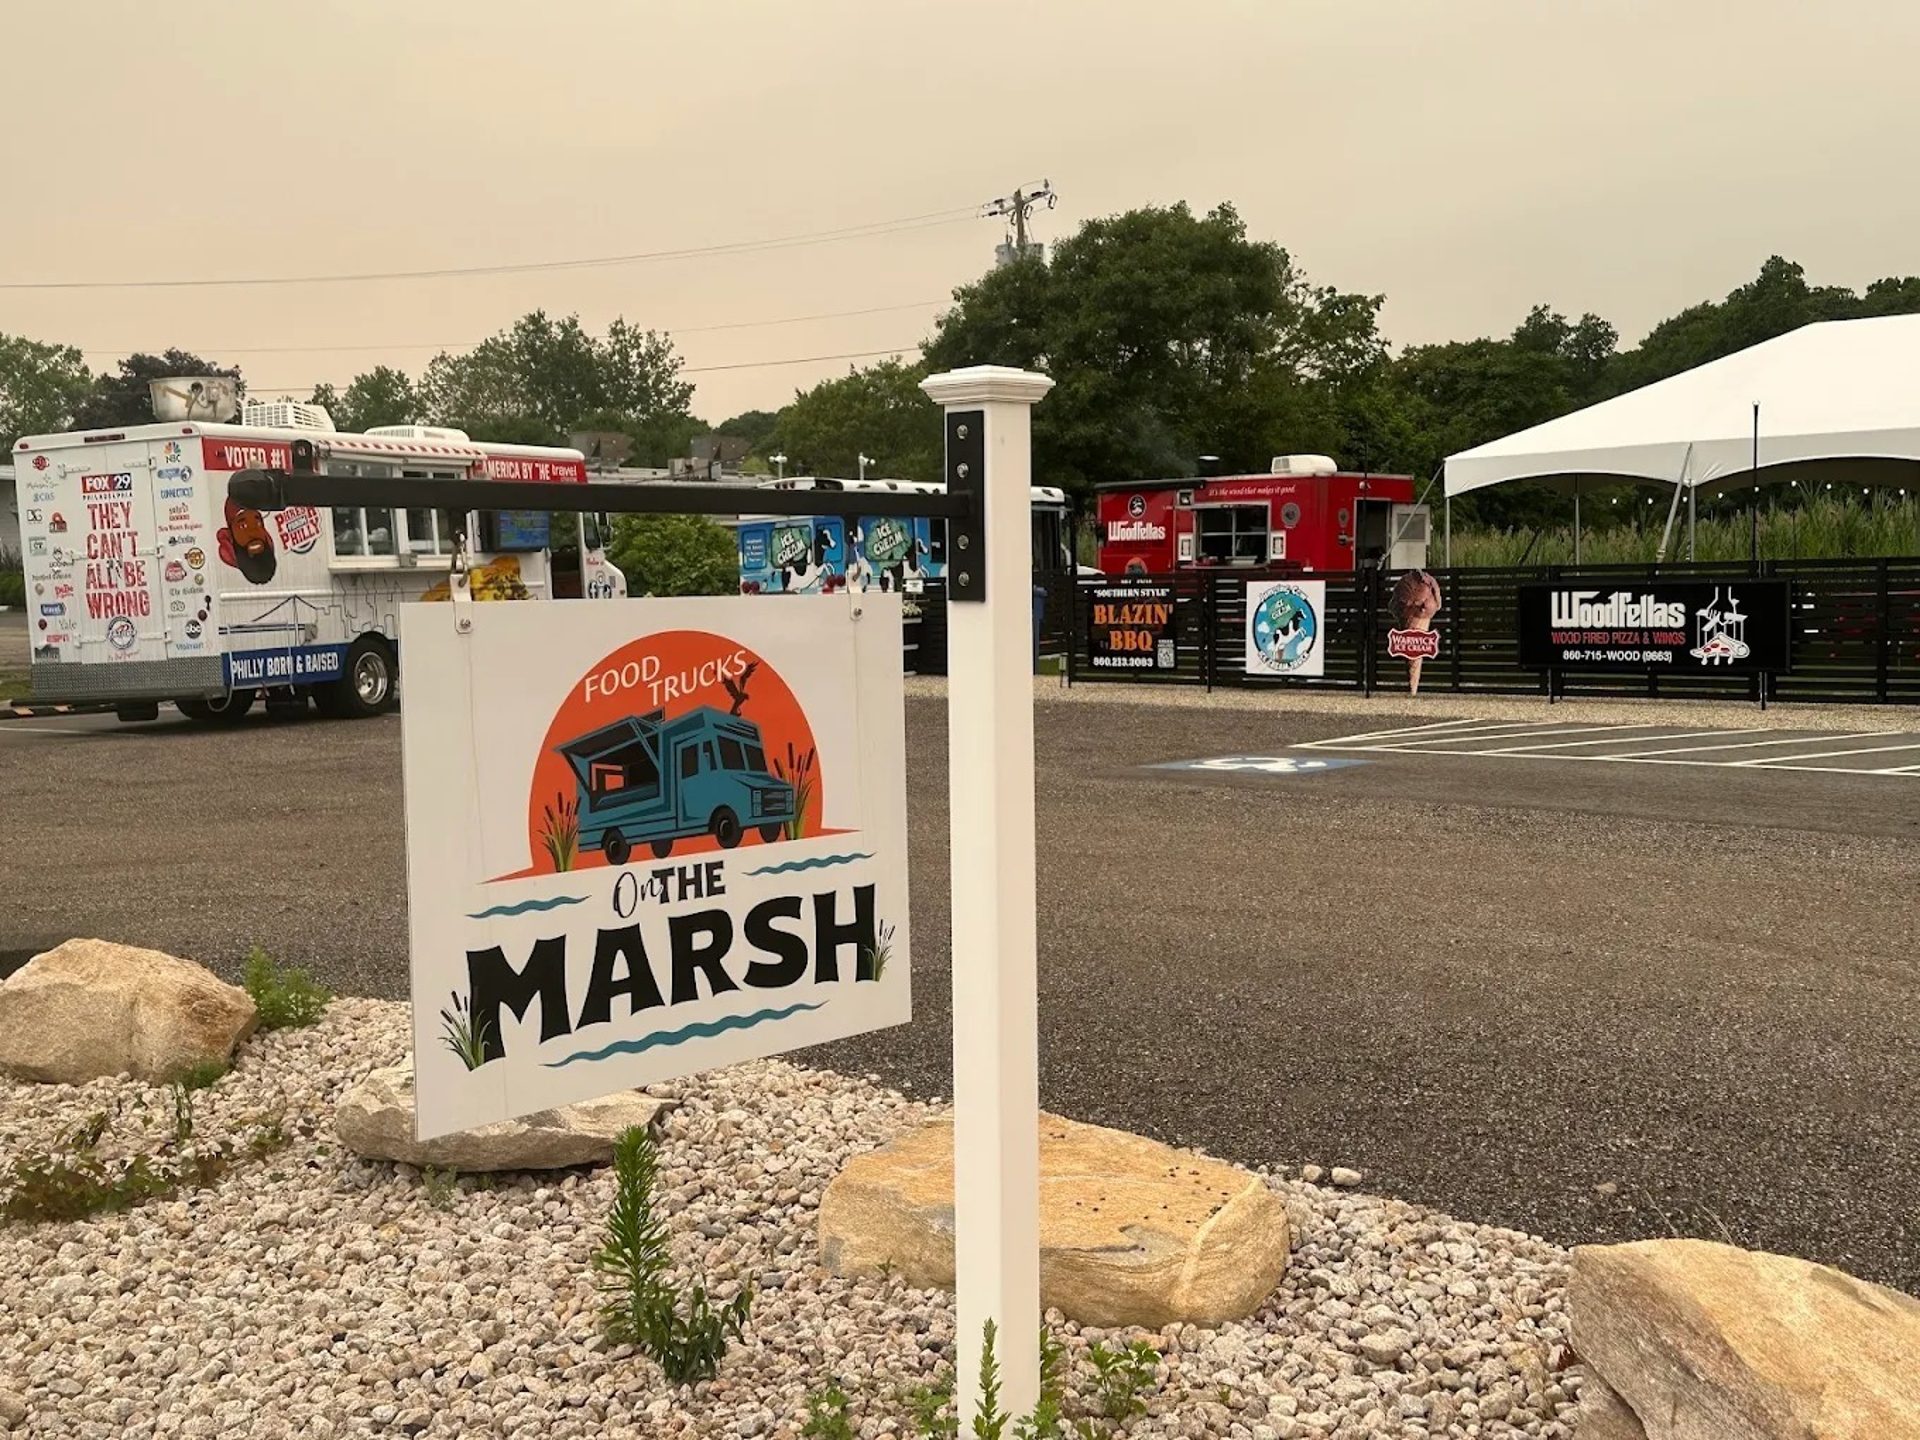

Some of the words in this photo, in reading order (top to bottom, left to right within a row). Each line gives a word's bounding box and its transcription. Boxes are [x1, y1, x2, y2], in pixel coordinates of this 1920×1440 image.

[166, 454, 181, 463] NBC
[271, 447, 287, 470] #1
[86, 476, 110, 491] FOX
[114, 474, 130, 490] 29
[522, 462, 533, 480] BY
[551, 463, 577, 476] travel
[82, 491, 133, 501] PHILADELPHIA
[87, 502, 132, 531] THEY
[280, 517, 320, 550] PHILLY
[781, 531, 796, 549] ICE
[877, 523, 892, 539] ICE
[87, 532, 139, 560] CAN'T
[777, 539, 806, 565] CREAM
[873, 530, 903, 556] CREAM
[86, 562, 118, 590] ALL
[123, 560, 148, 588] BE
[86, 590, 151, 619] WRONG
[1093, 603, 1174, 625] BLAZIN'
[1109, 630, 1154, 652] BBQ
[1391, 634, 1436, 647] WARWICK
[1551, 631, 1581, 645] WOOD
[1582, 631, 1610, 645] FIRED
[1611, 631, 1640, 645] PIZZA
[1642, 631, 1651, 645] &
[1652, 631, 1687, 645] WINGS
[232, 656, 264, 680] PHILLY
[295, 657, 304, 670] &
[305, 652, 339, 672] RAISED
[1562, 650, 1641, 661] 860-715-WOOD
[584, 655, 661, 704] FOOD
[647, 650, 747, 707] TRUCKS
[612, 871, 663, 919] On
[652, 860, 726, 905] THE
[465, 883, 878, 1071] MARSH
